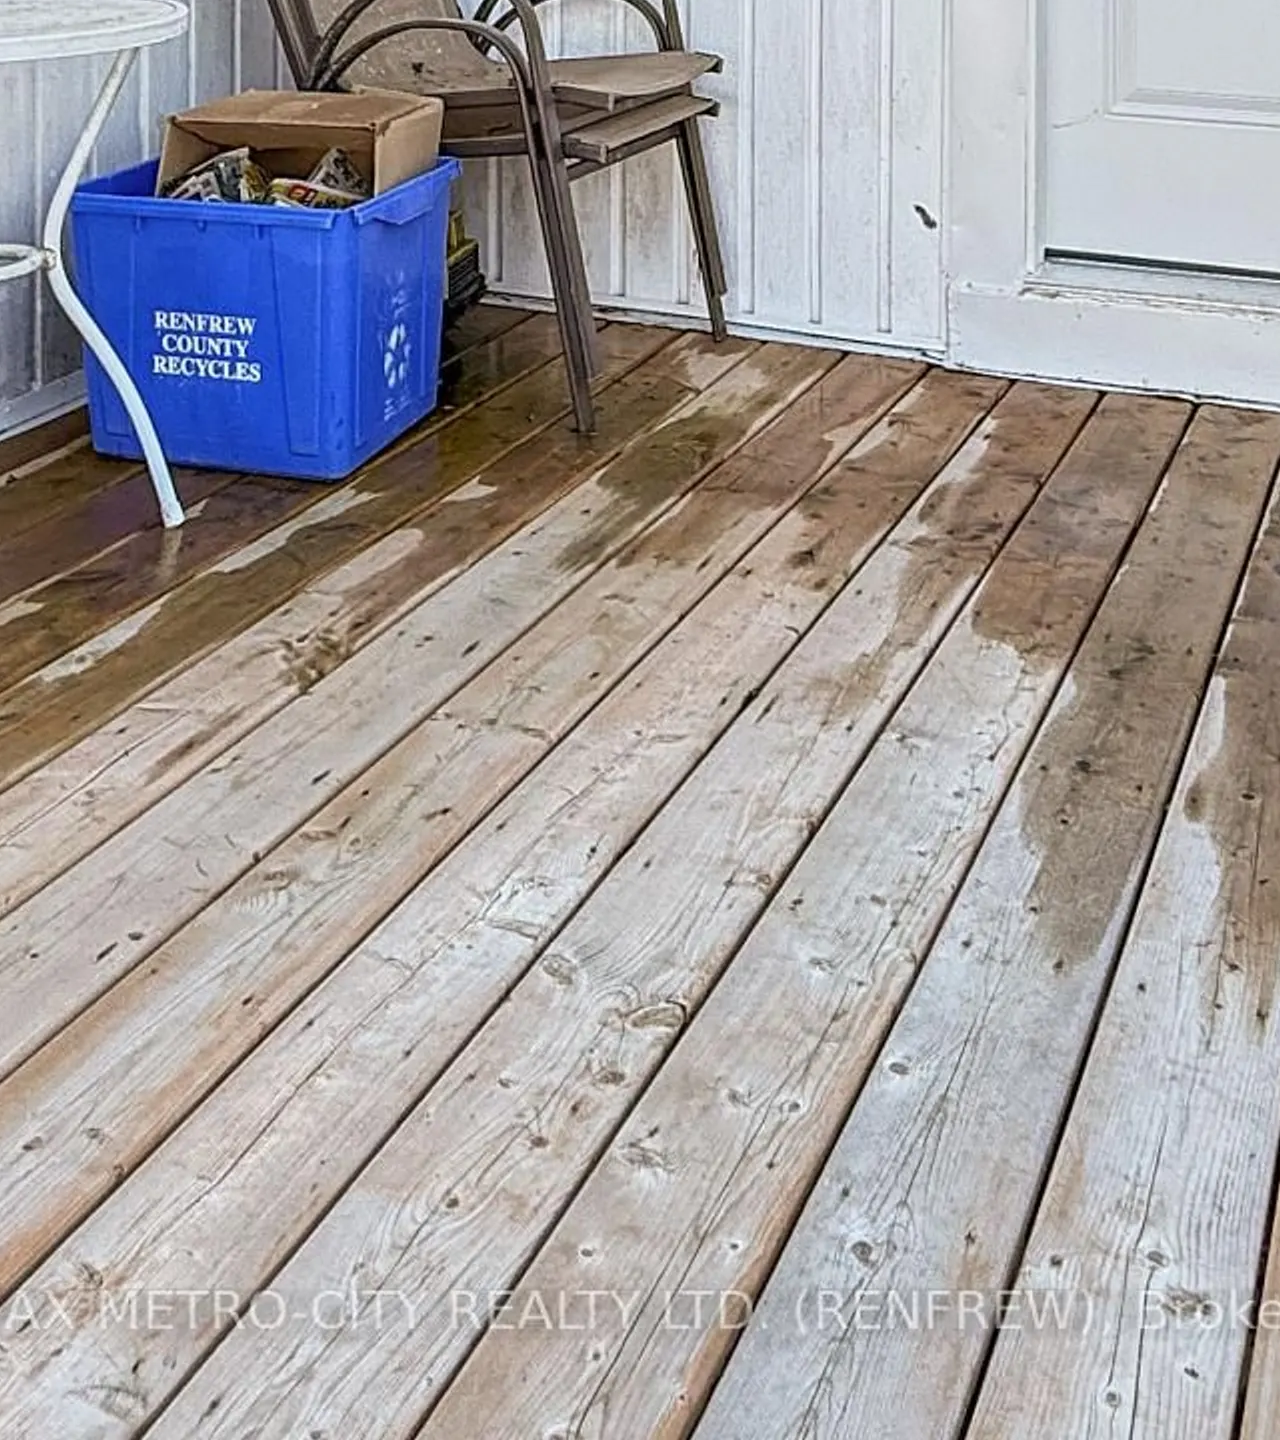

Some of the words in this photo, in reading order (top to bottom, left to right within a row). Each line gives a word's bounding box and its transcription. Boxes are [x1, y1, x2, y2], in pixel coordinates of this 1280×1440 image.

[154, 311, 257, 335] RENFREW
[161, 334, 249, 357] COUNTY
[152, 355, 261, 382] RECYCLES
